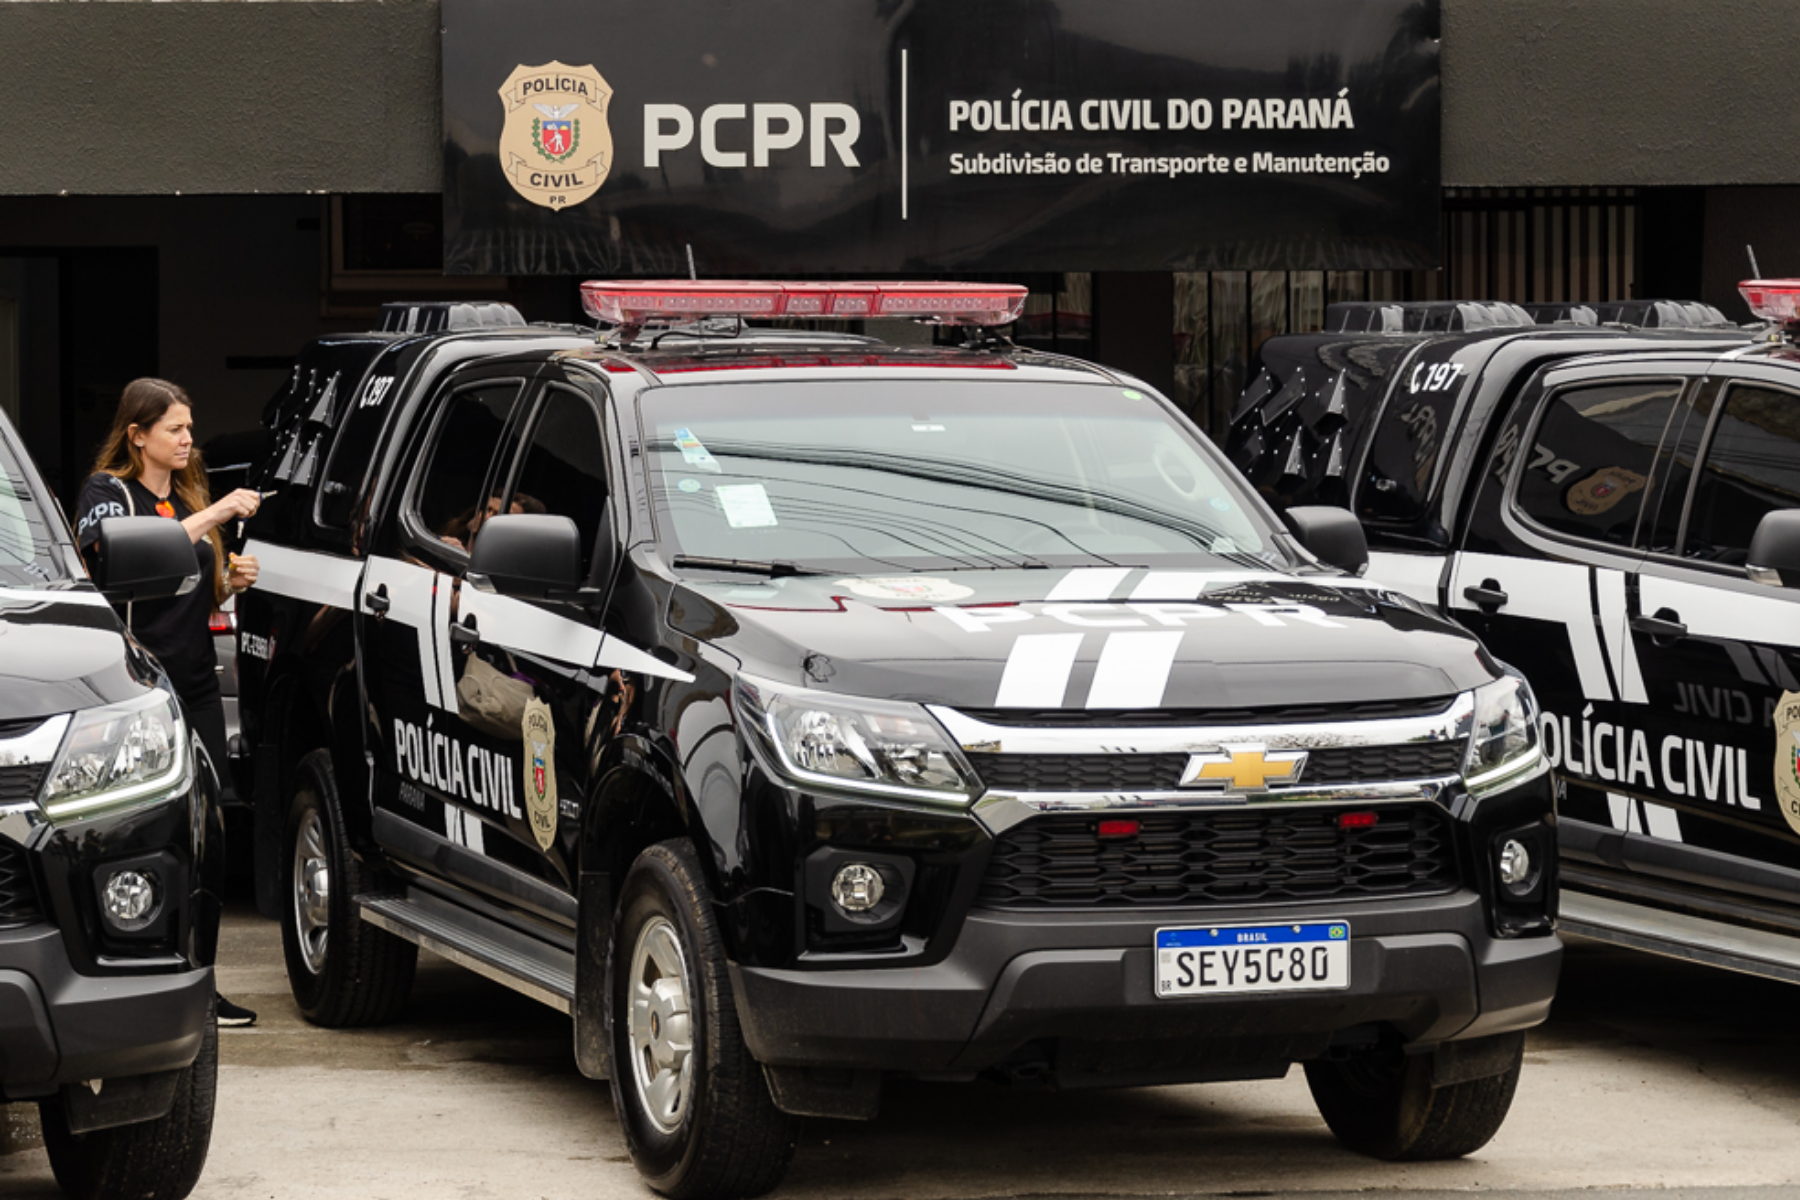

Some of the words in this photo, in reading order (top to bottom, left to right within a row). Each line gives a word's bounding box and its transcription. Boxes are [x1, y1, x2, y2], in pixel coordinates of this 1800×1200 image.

[523, 74, 588, 96] POLÍCIA
[949, 87, 1074, 131] POLÍCIA
[1080, 99, 1160, 131] CIVIL
[1168, 99, 1213, 131] DO
[1222, 87, 1355, 130] PARANÁ
[643, 102, 861, 168] PCPR
[529, 173, 584, 188] CIVIL
[949, 151, 1072, 175] Subdivisão
[1075, 152, 1103, 174] de
[1107, 152, 1230, 179] Transporte
[1233, 158, 1248, 174] e
[1252, 151, 1390, 179] Manutenção
[549, 195, 566, 204] PR
[1421, 362, 1465, 391] 197
[78, 500, 125, 536] PCPR
[930, 602, 1349, 633] PCPR
[394, 713, 468, 799] POLÍCIA
[467, 744, 522, 821] CIVIL
[1540, 702, 1656, 789] OLÍCIA
[1660, 734, 1761, 811] CIVIL
[1236, 932, 1268, 944] BRASIL
[1176, 946, 1329, 988] SEY5C80
